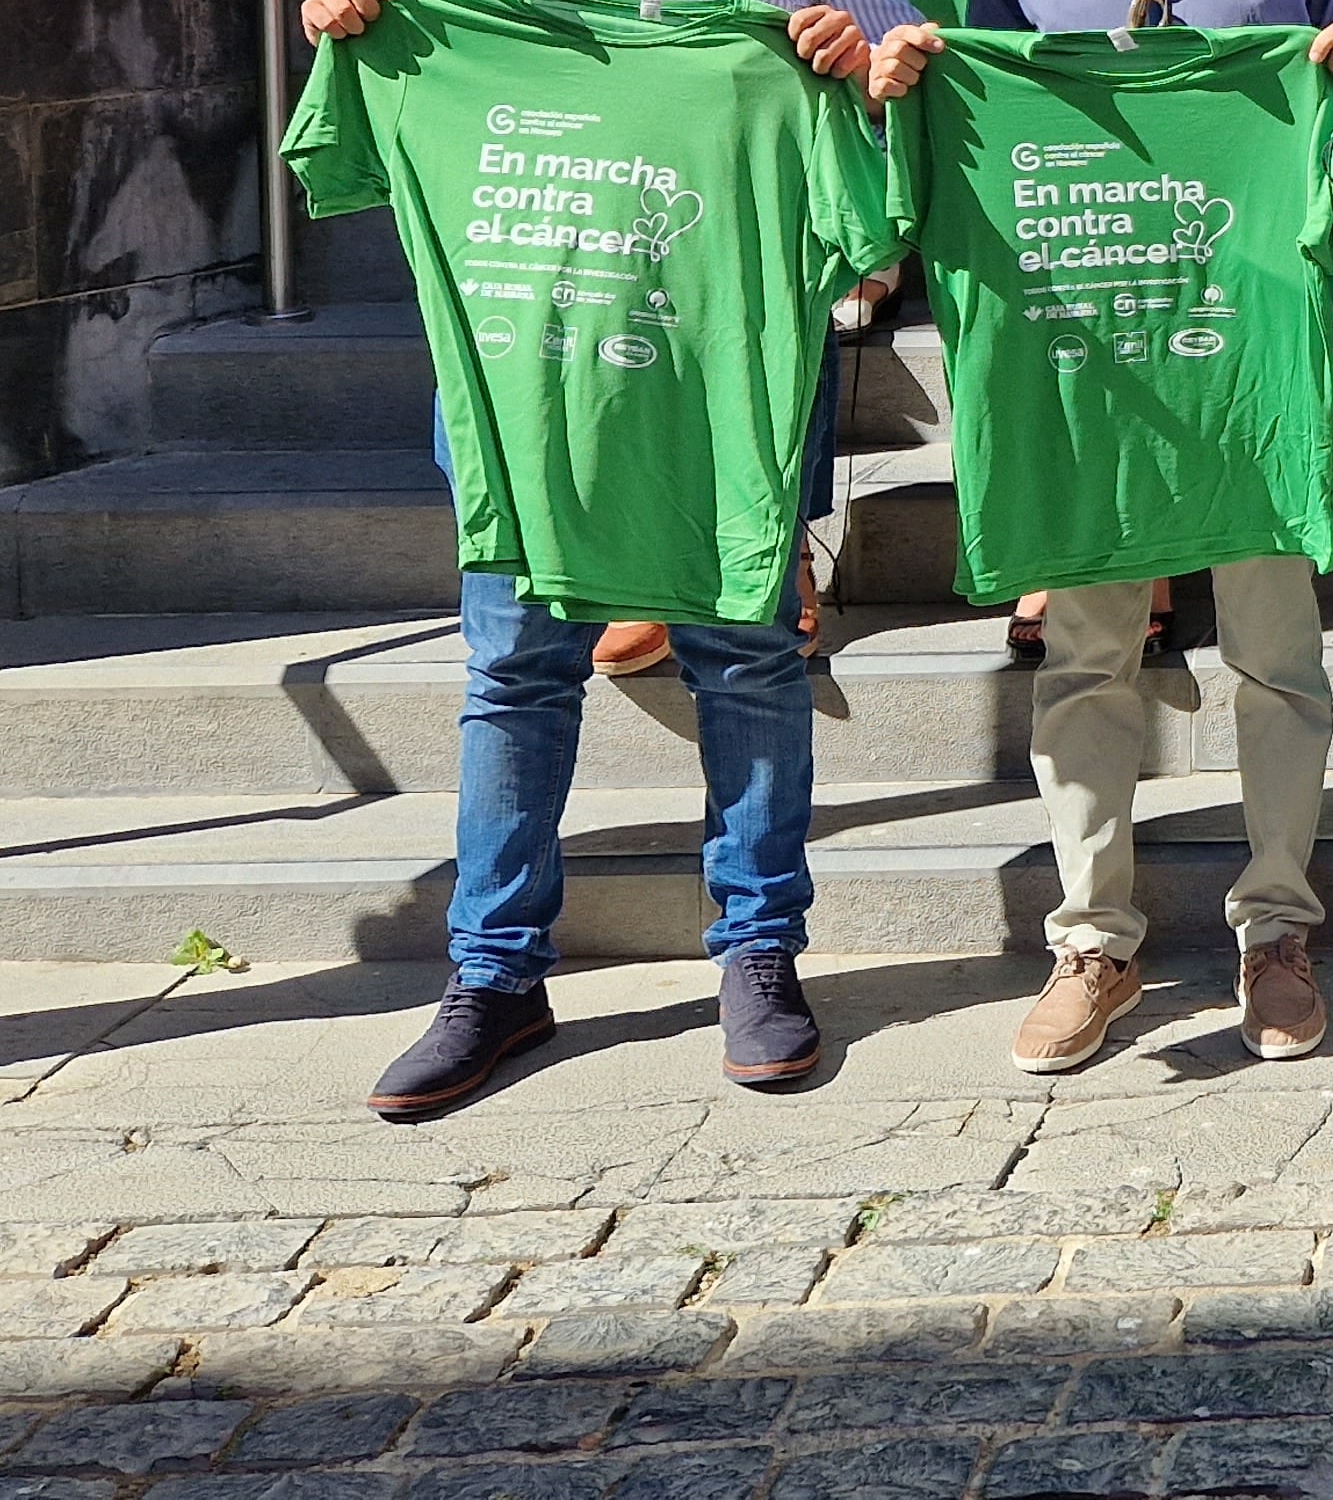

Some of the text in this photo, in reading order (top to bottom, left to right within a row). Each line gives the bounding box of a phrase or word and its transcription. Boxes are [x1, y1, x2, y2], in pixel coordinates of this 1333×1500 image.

[478, 143, 677, 191] En marcha
[472, 184, 594, 216] contra
[1013, 173, 1205, 208] En marcha
[466, 213, 639, 255] el cáncer
[1016, 208, 1133, 240] contra
[1018, 239, 1184, 272] el cáncer
